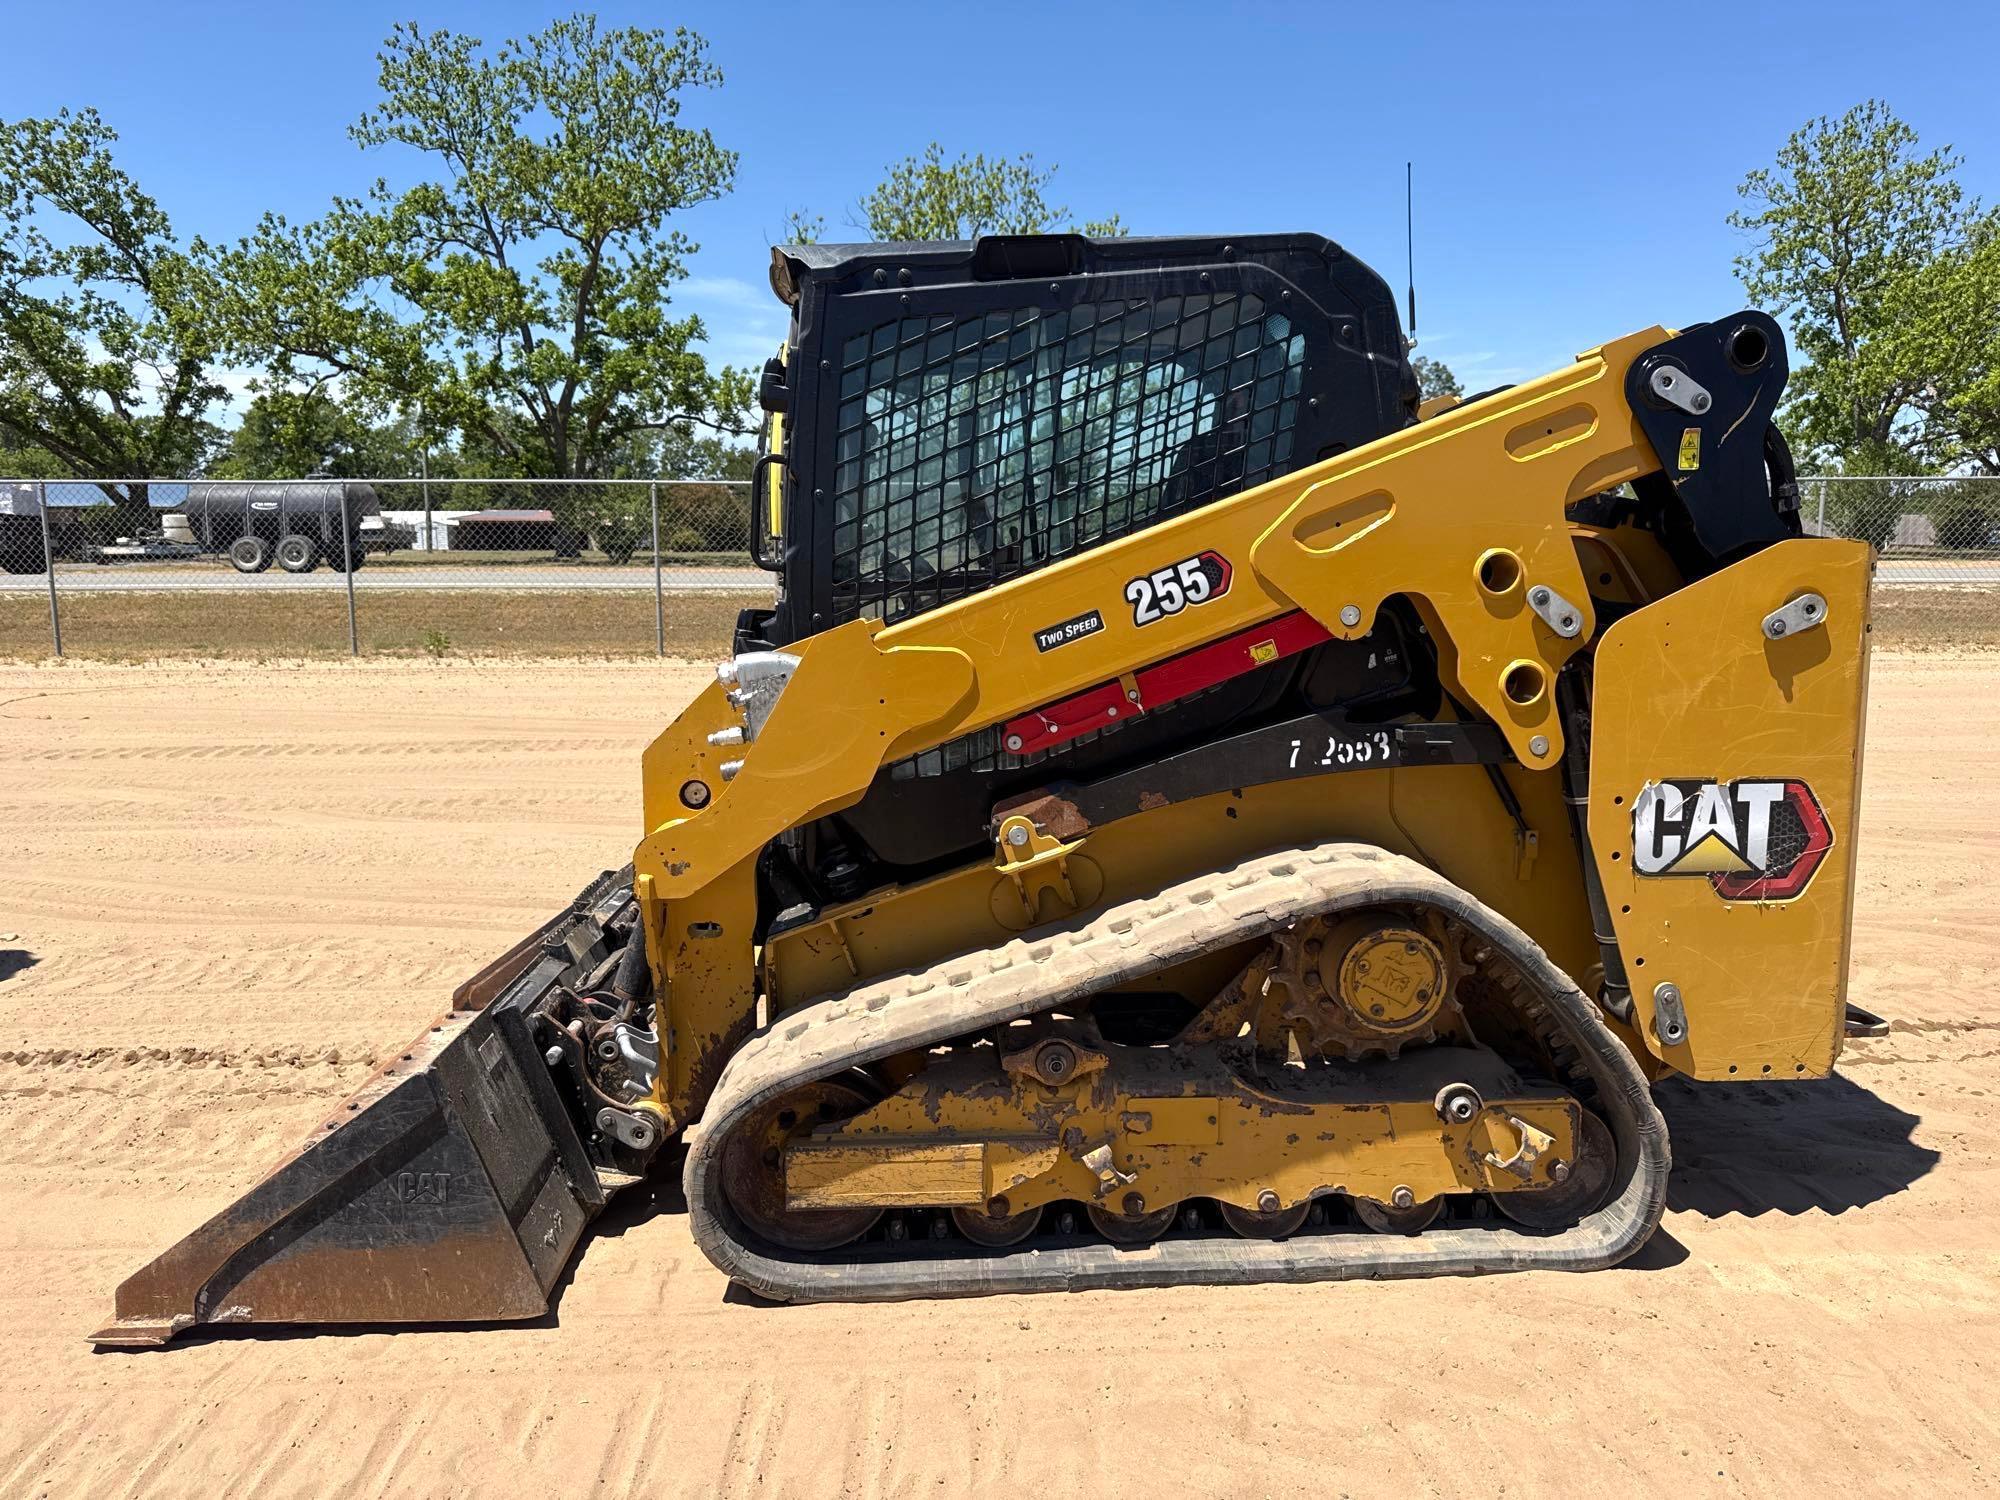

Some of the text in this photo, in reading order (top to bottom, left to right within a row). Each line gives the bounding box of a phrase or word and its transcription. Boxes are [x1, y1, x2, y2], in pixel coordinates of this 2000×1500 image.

[1126, 557, 1210, 625] 255
[1634, 782, 1785, 873] CAT
[398, 1172, 451, 1203] CAT
